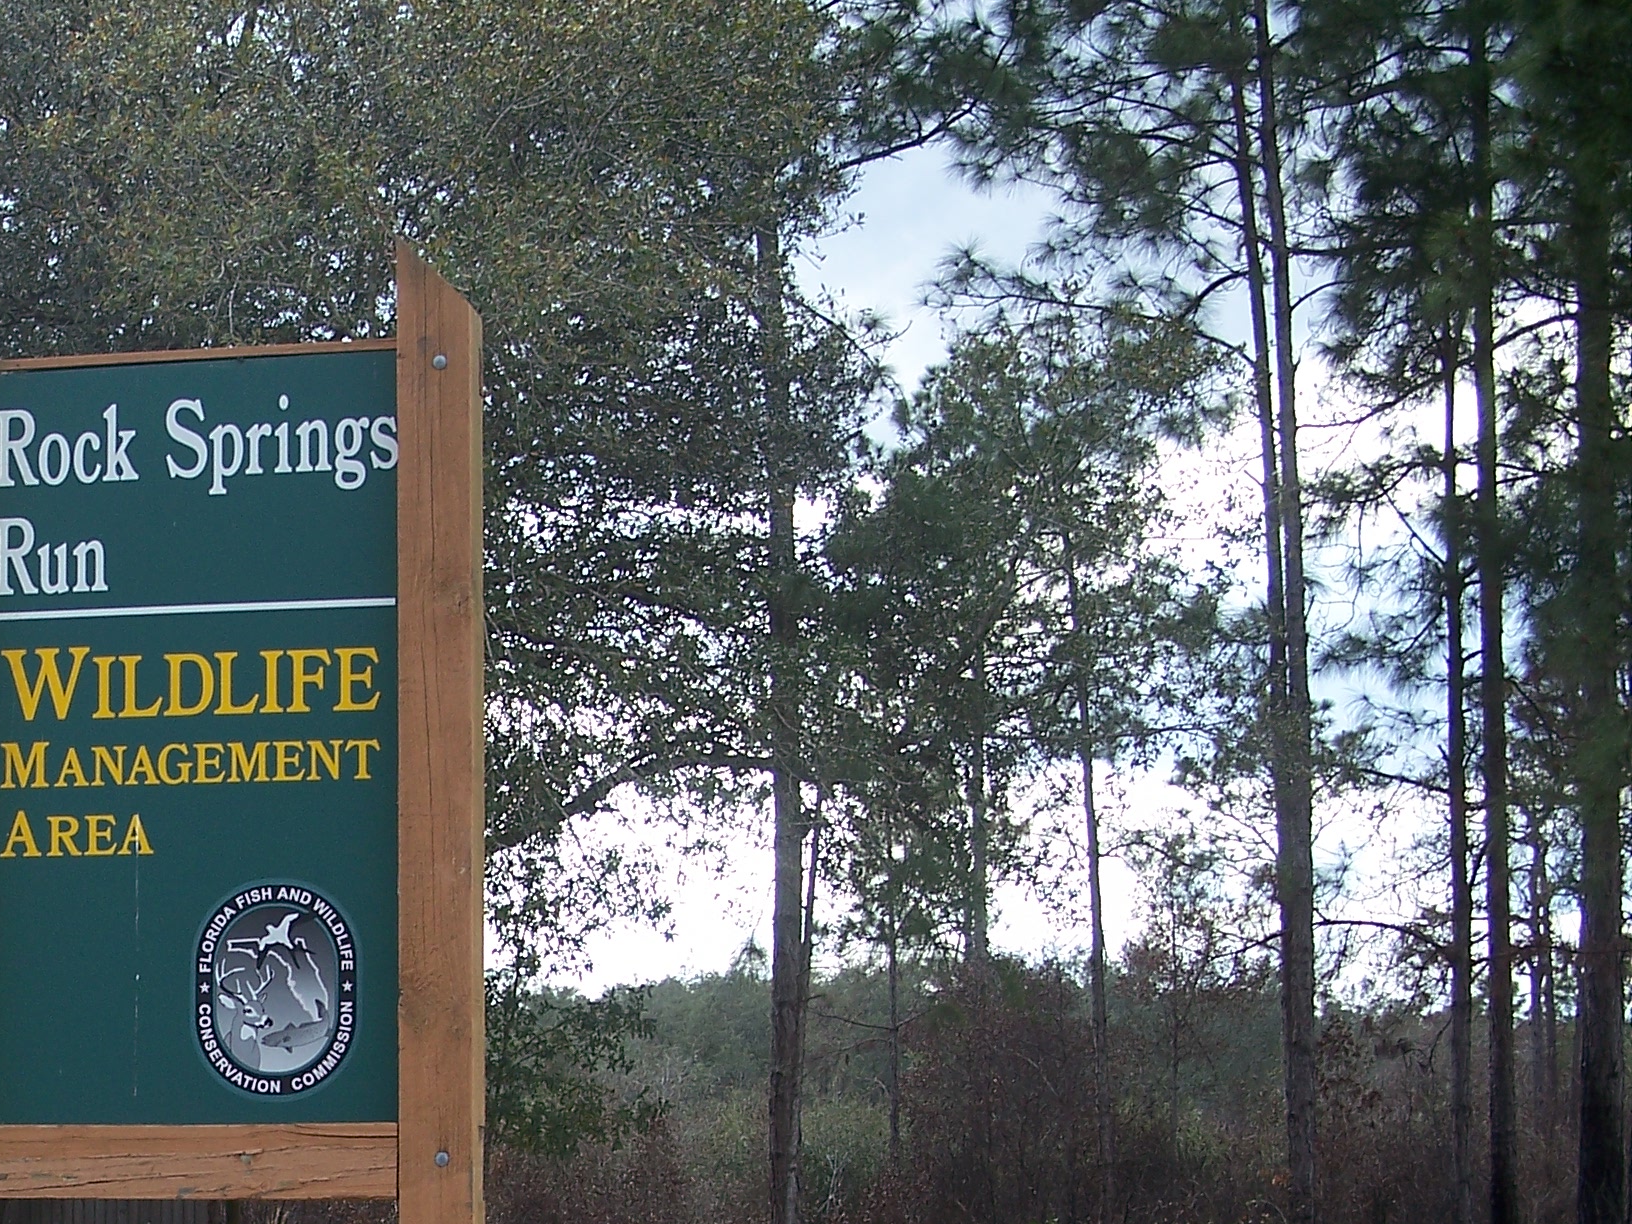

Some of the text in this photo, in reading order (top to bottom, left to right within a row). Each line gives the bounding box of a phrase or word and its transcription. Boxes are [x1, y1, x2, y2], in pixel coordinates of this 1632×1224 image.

[166, 394, 399, 495] Springs
[1, 646, 382, 722] WILDLIFE
[0, 739, 381, 789] MANAGEMENT
[0, 809, 155, 858] AREA
[199, 887, 354, 973] FLORIDA FISH AND WILDLIFE
[198, 1001, 353, 1093] CONSERVATION COMMISSION
